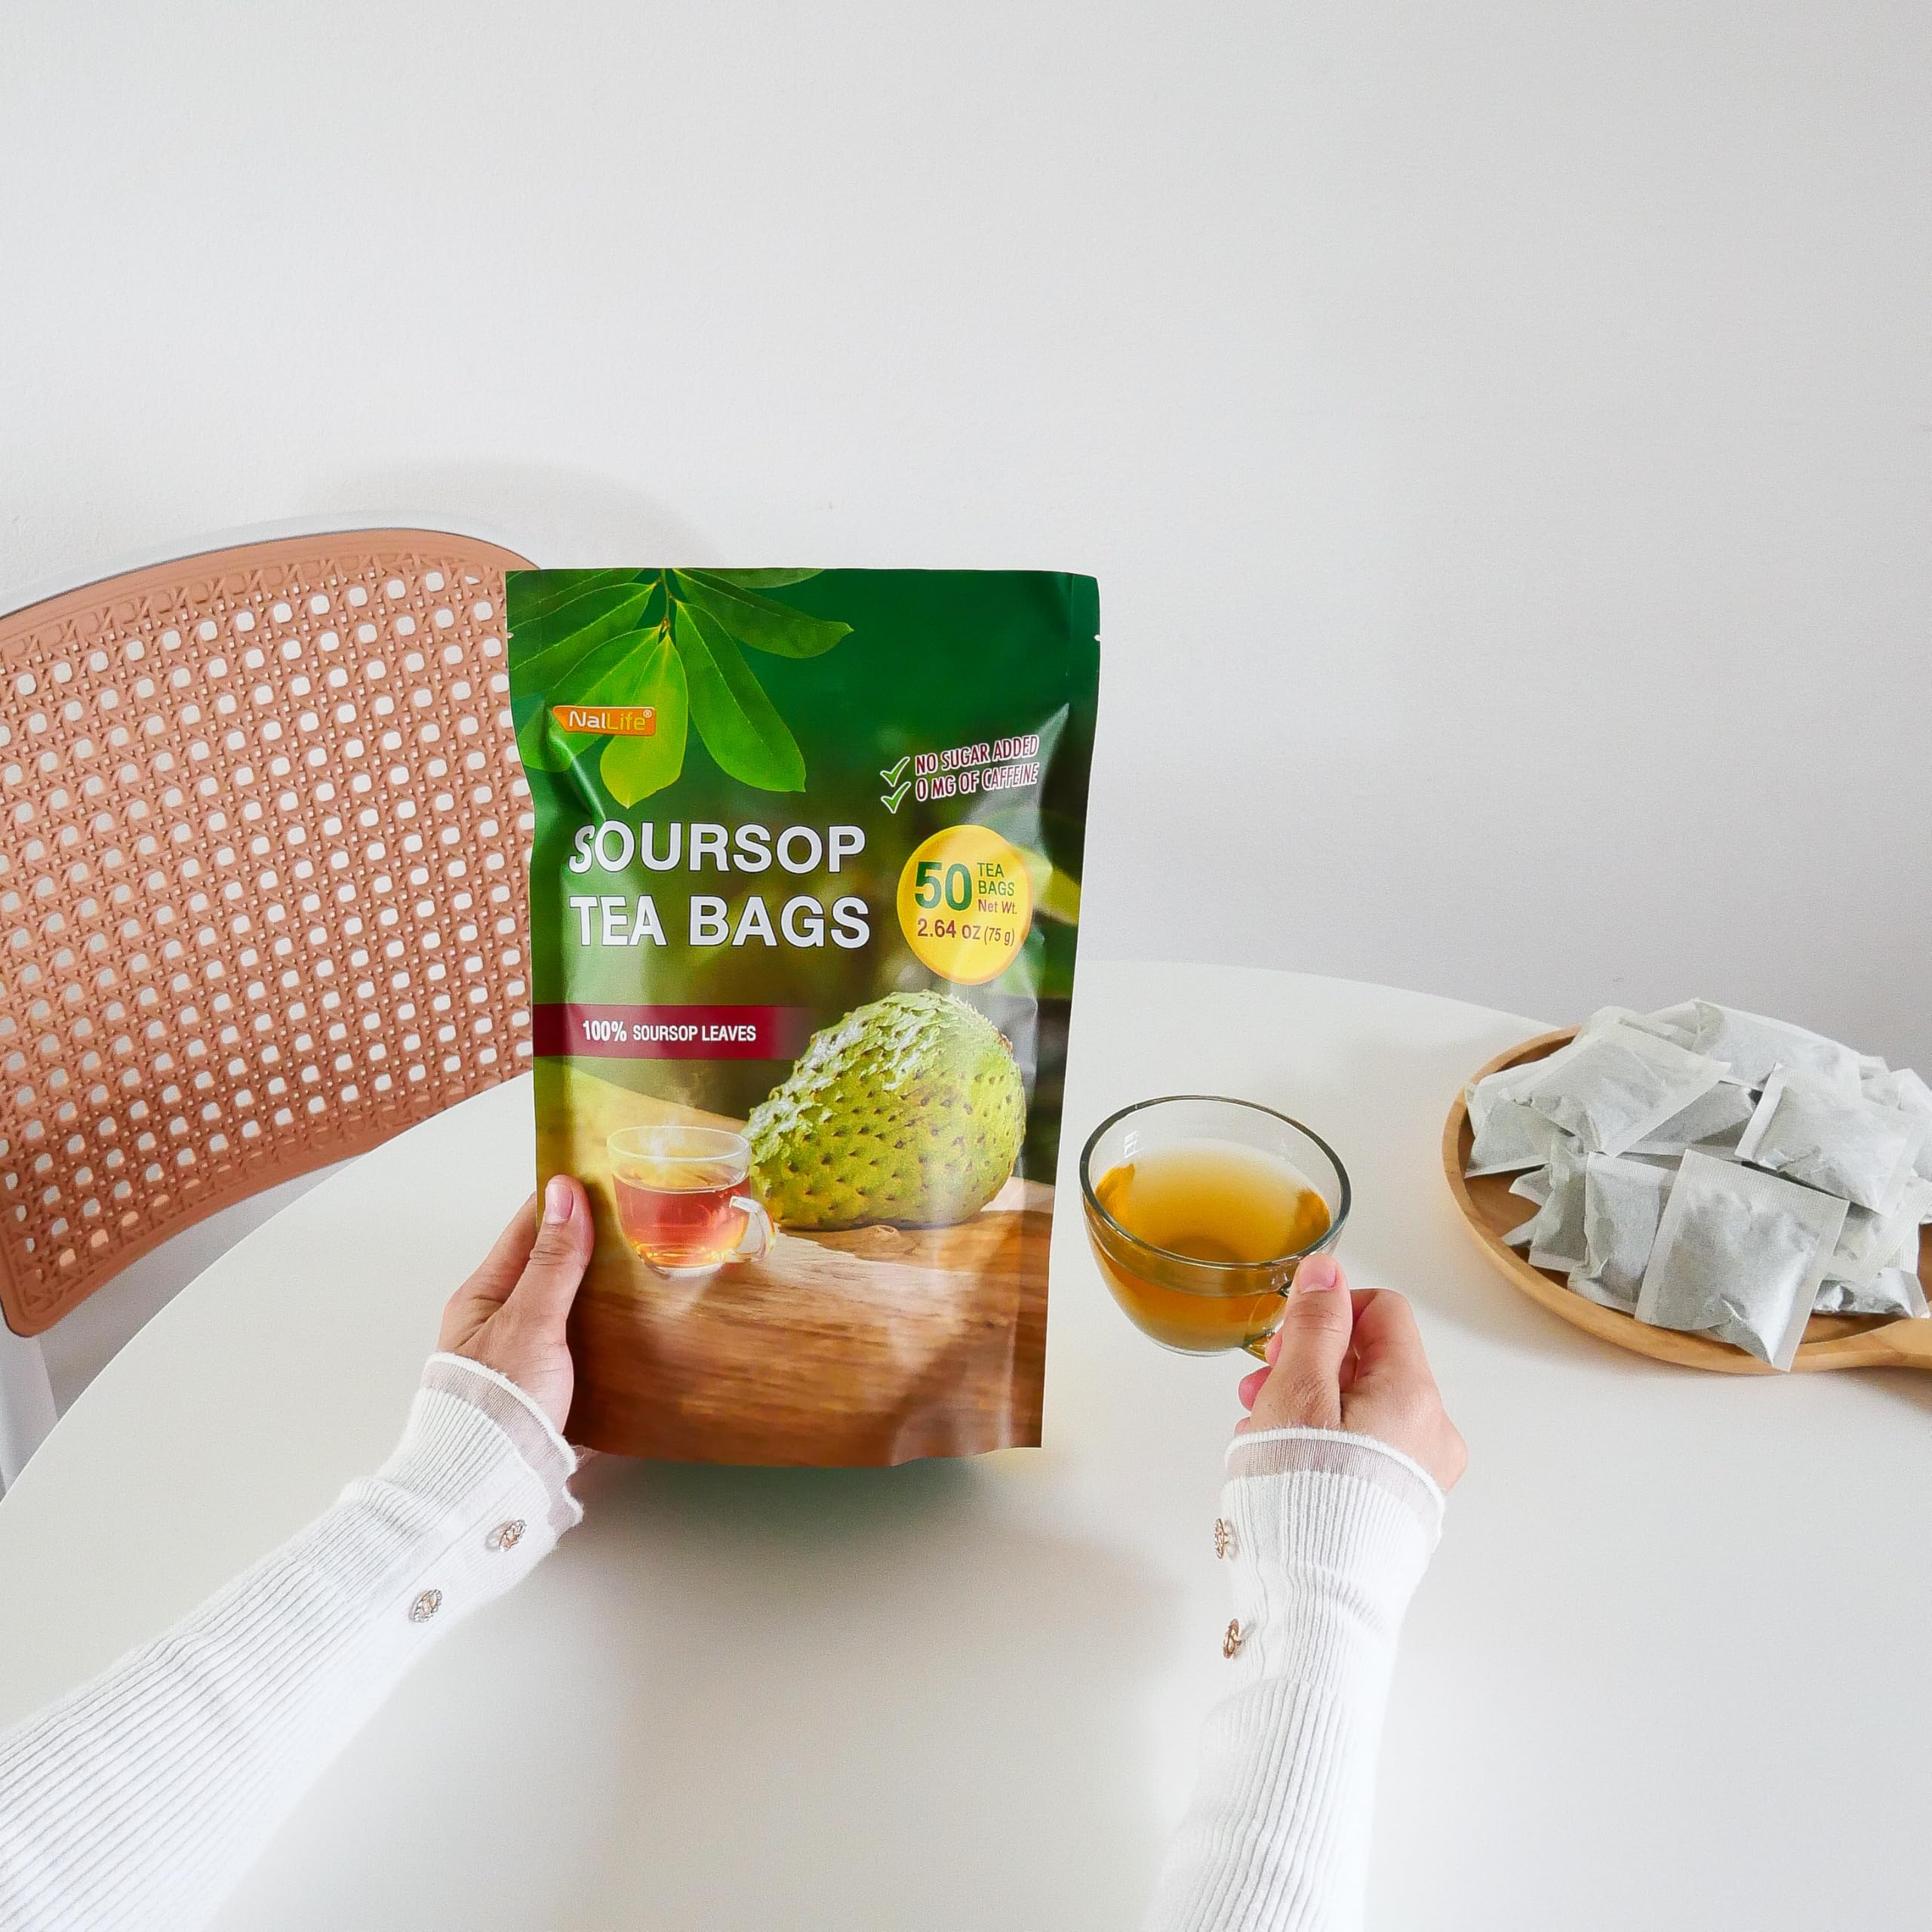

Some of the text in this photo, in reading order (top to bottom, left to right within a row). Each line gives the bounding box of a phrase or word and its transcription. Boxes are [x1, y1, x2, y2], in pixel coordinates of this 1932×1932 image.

[915, 734, 1040, 777] NO SUGAR ADDED
[915, 762, 1040, 801] 0 MG OF CAFFEINE
[568, 819, 866, 874] SOURSOP
[915, 861, 973, 911] 50
[977, 862, 1004, 878] TEA
[978, 880, 1014, 896] BAGS
[568, 894, 870, 949] TEA BAGS
[977, 899, 1017, 915] Net Wt.
[917, 918, 956, 939] 2.64
[984, 926, 1001, 945] (75
[1004, 928, 1015, 946] g)
[583, 1020, 756, 1042] 100% SOURSOP LEAVES
